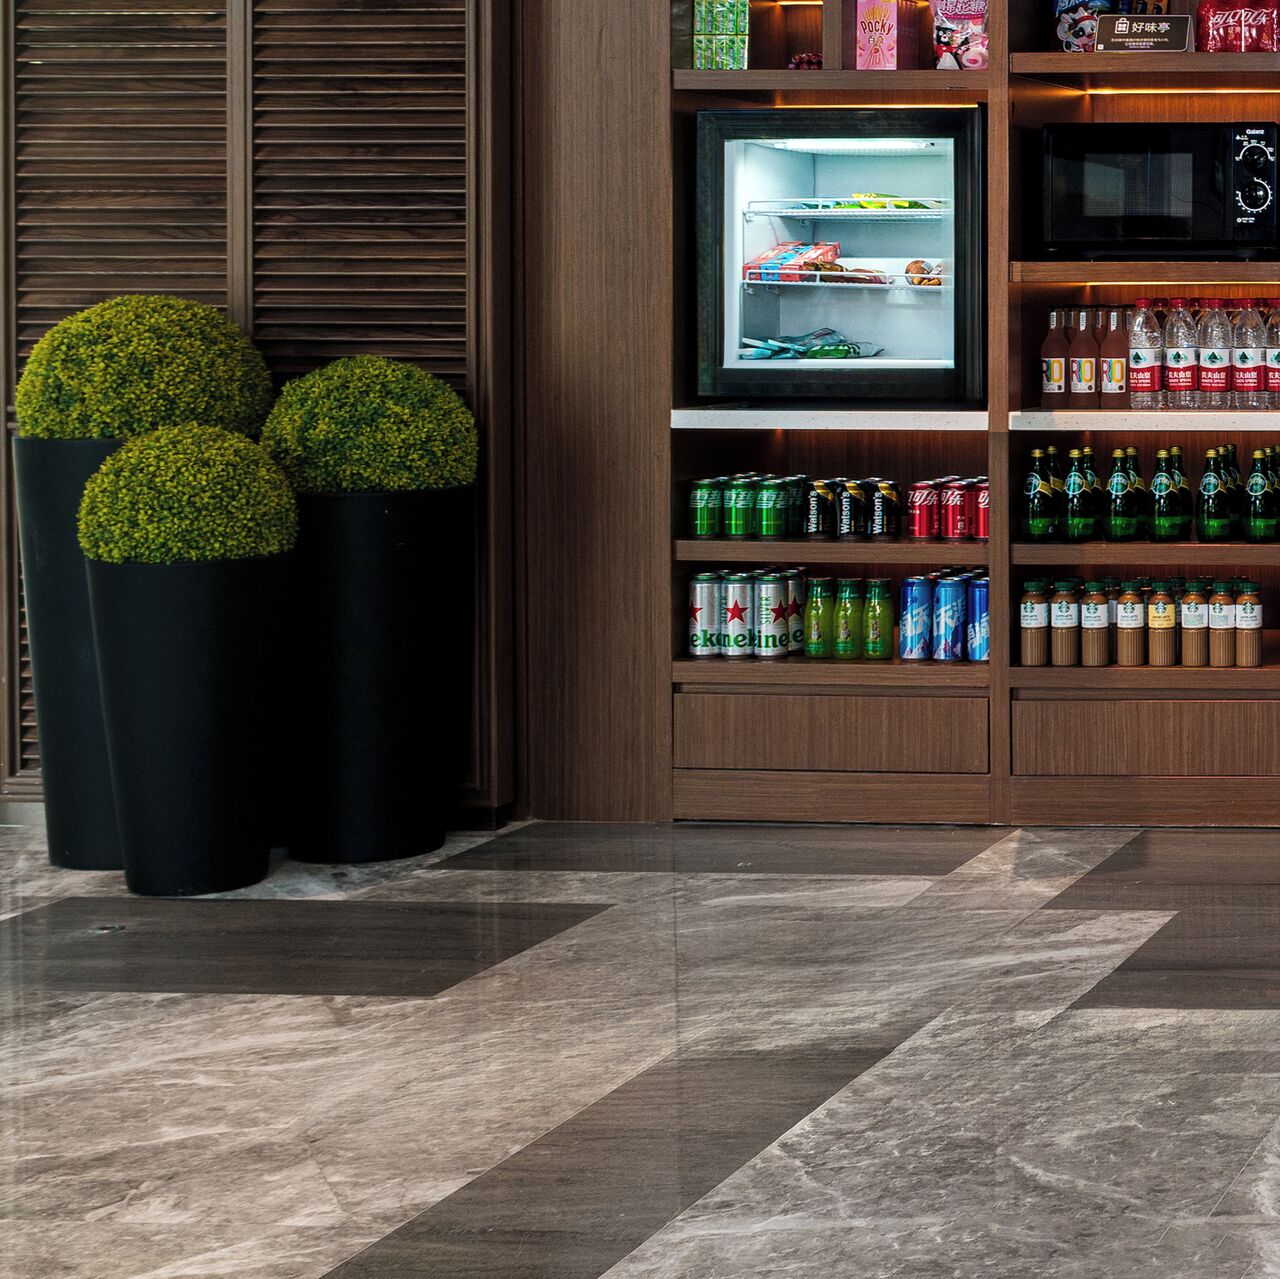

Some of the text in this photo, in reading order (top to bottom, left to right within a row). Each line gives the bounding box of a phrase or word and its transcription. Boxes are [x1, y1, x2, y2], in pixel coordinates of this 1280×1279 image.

[860, 18, 894, 35] Pocky
[1131, 22, 1171, 33] 好味亭
[1041, 359, 1063, 383] RIO
[1070, 359, 1095, 384] RIO
[1101, 359, 1125, 384] RIO
[807, 490, 818, 533] Watson's
[840, 491, 850, 534] Watson's
[873, 491, 883, 534] Watson's
